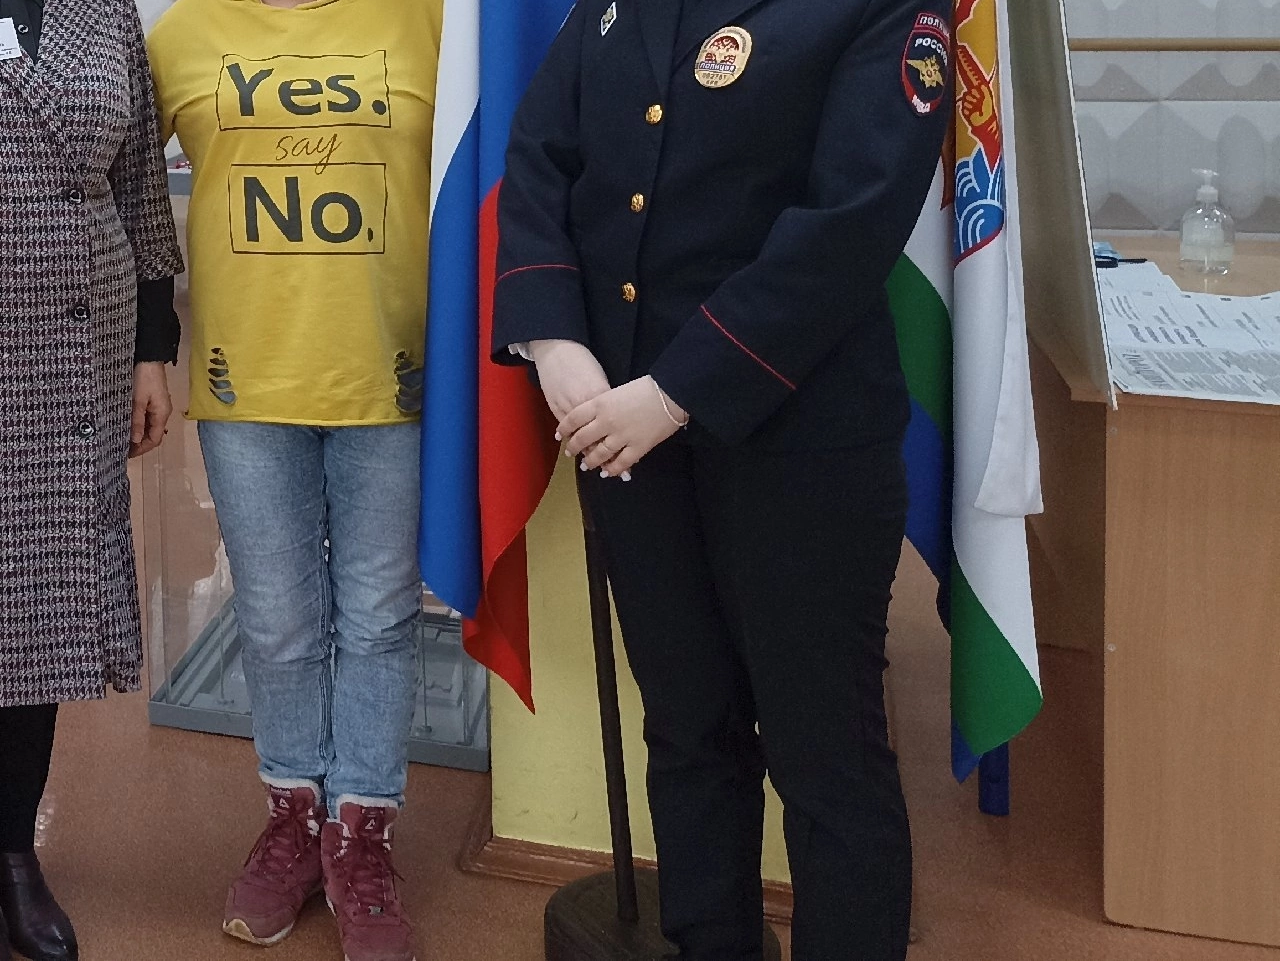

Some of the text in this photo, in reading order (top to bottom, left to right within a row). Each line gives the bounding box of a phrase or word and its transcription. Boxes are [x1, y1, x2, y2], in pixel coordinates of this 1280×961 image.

[226, 62, 387, 117] Yes.
[275, 133, 343, 175] say
[243, 176, 374, 244] No.
